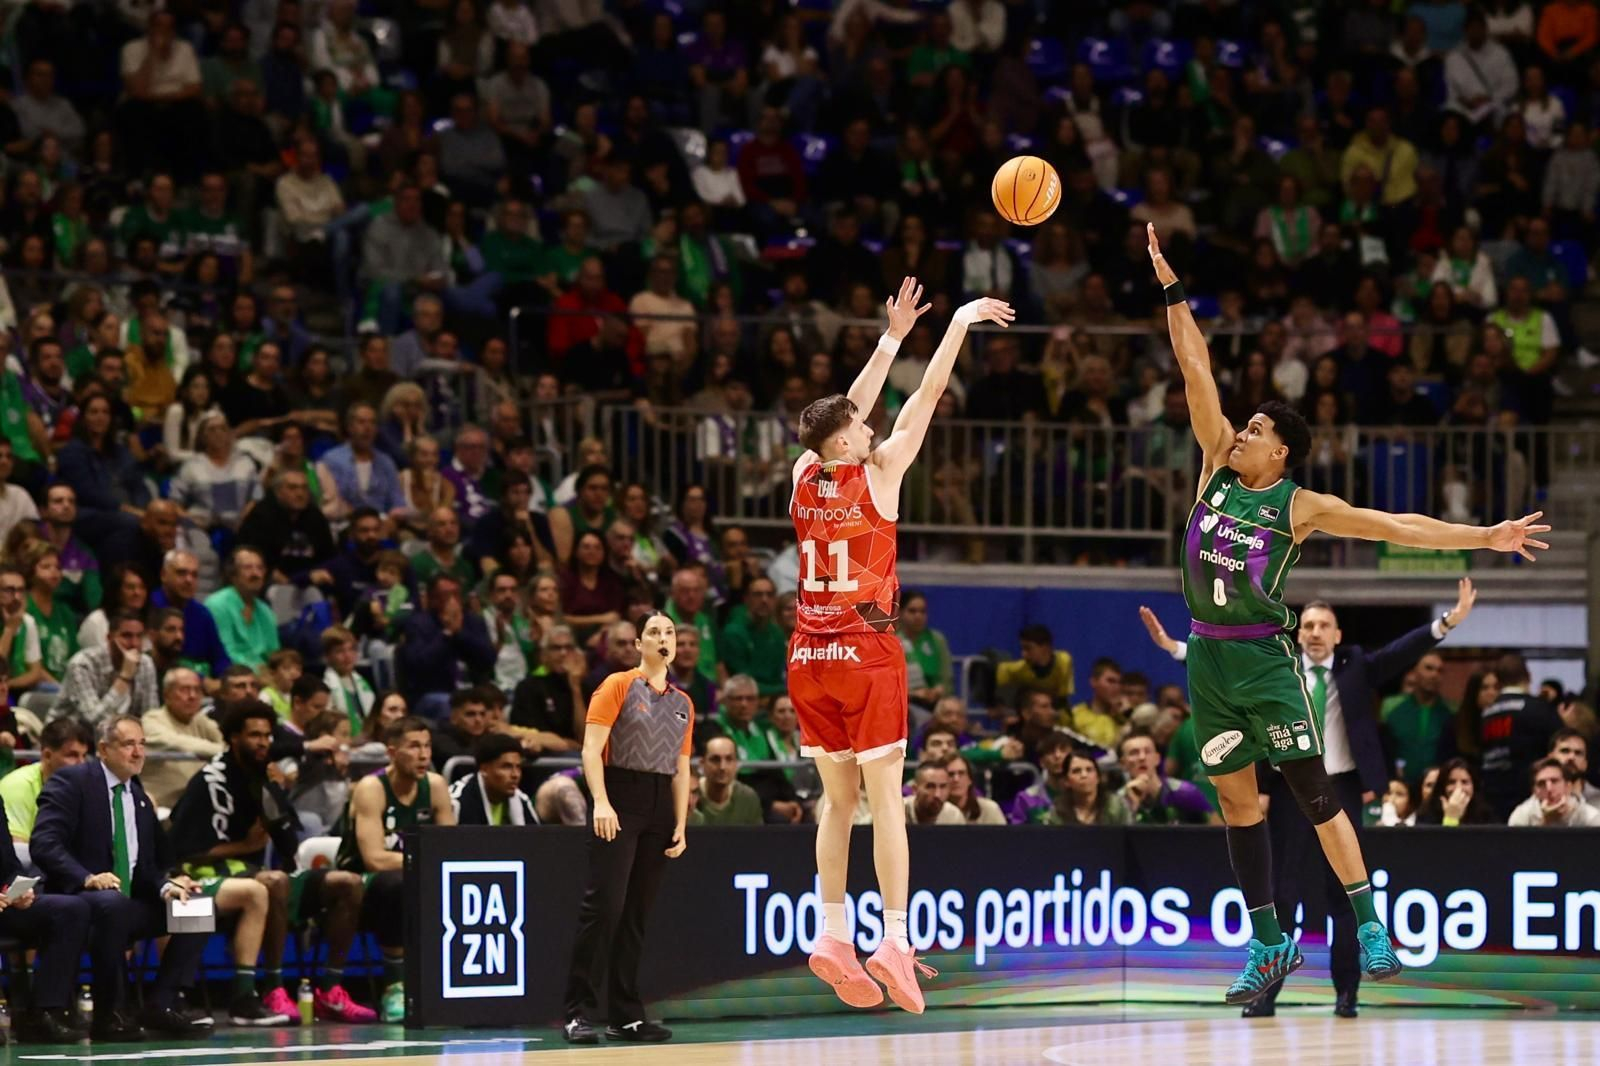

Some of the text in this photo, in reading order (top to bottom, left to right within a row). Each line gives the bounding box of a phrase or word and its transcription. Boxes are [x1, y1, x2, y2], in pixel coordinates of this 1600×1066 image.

[1217, 524, 1265, 550] Unicaja
[801, 540, 858, 592] 11
[1199, 549, 1245, 572] málaga
[1213, 578, 1227, 606] 0
[790, 642, 861, 665] Aquaflix
[975, 868, 1190, 965] partidos
[1513, 871, 1600, 950] En
